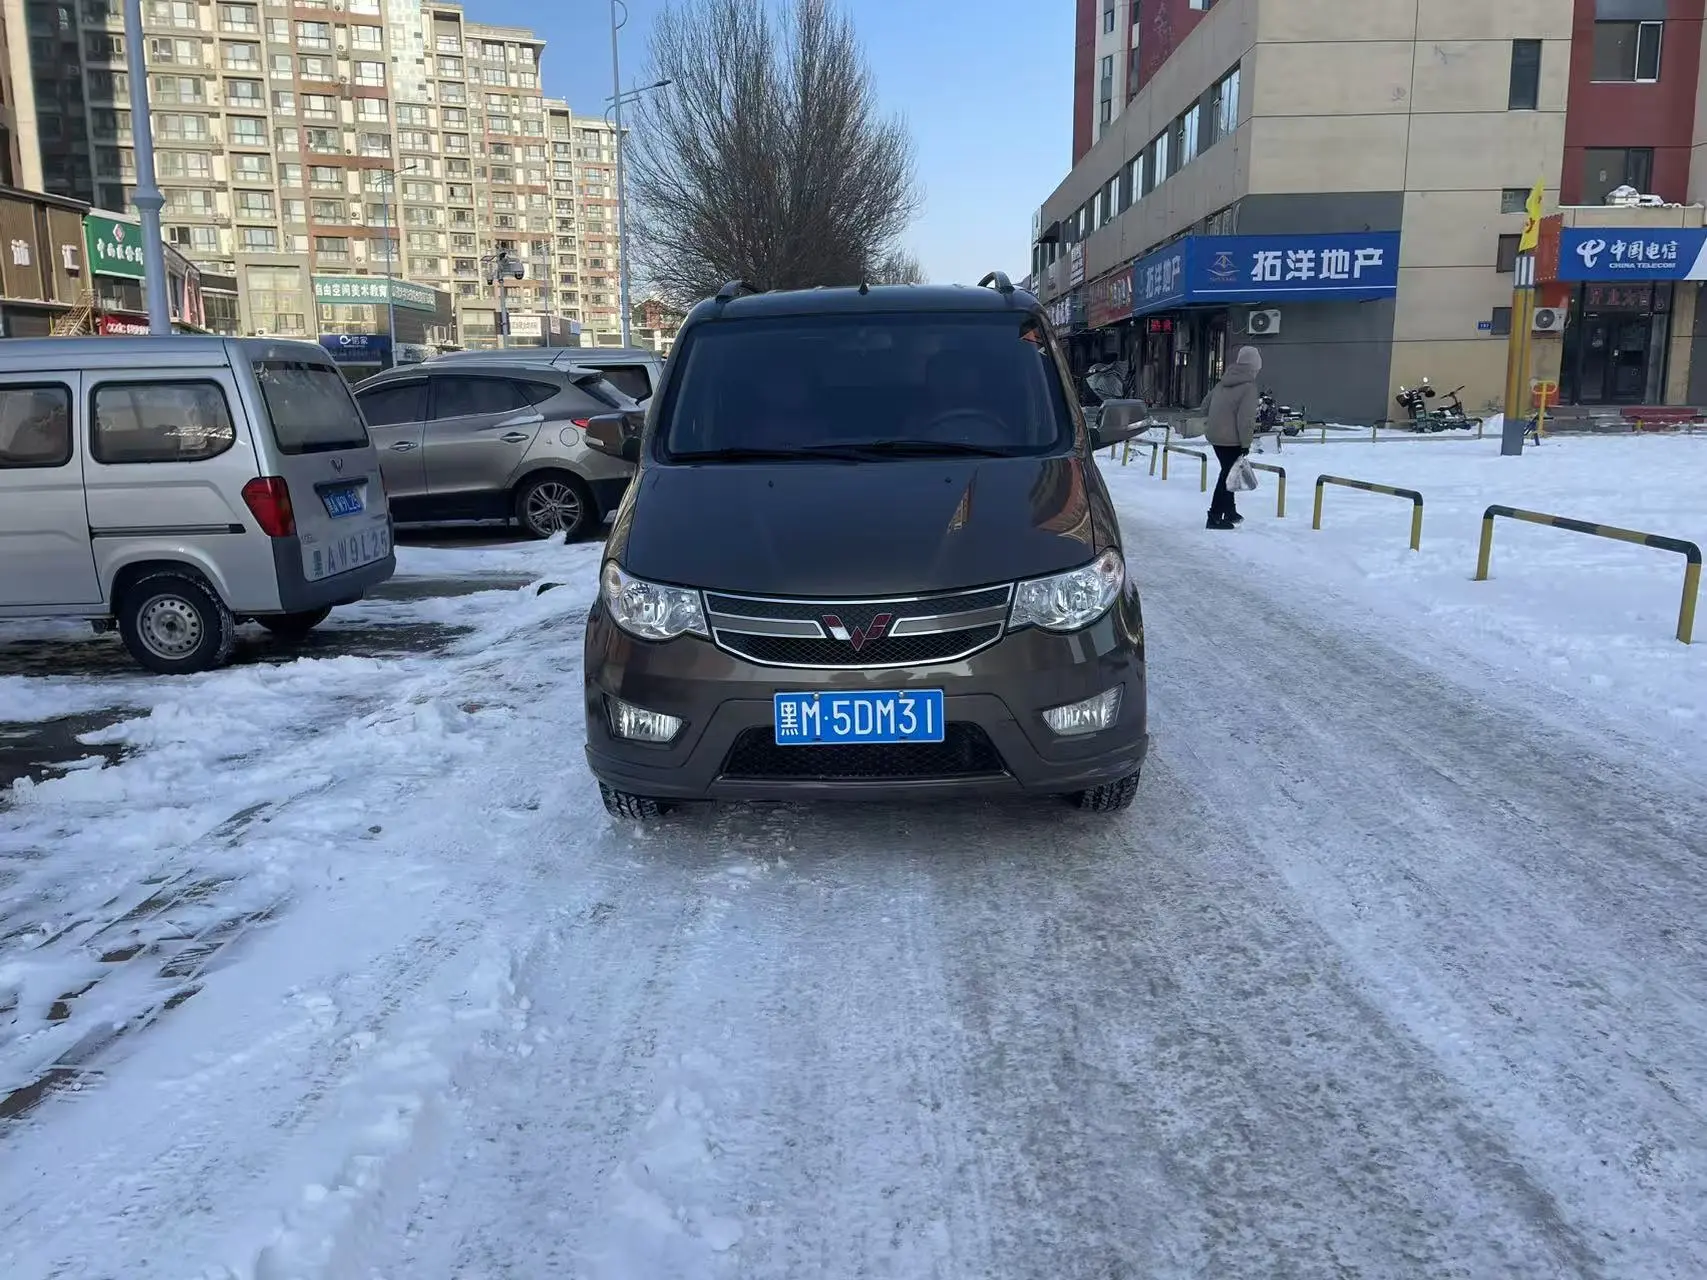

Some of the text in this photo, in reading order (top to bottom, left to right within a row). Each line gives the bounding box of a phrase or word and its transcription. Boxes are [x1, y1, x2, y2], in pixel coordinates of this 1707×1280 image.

[1251, 248, 1383, 281] 拓洋地产
[1610, 240, 1679, 261] 中国电信
[1146, 255, 1181, 299] 拓洋地产
